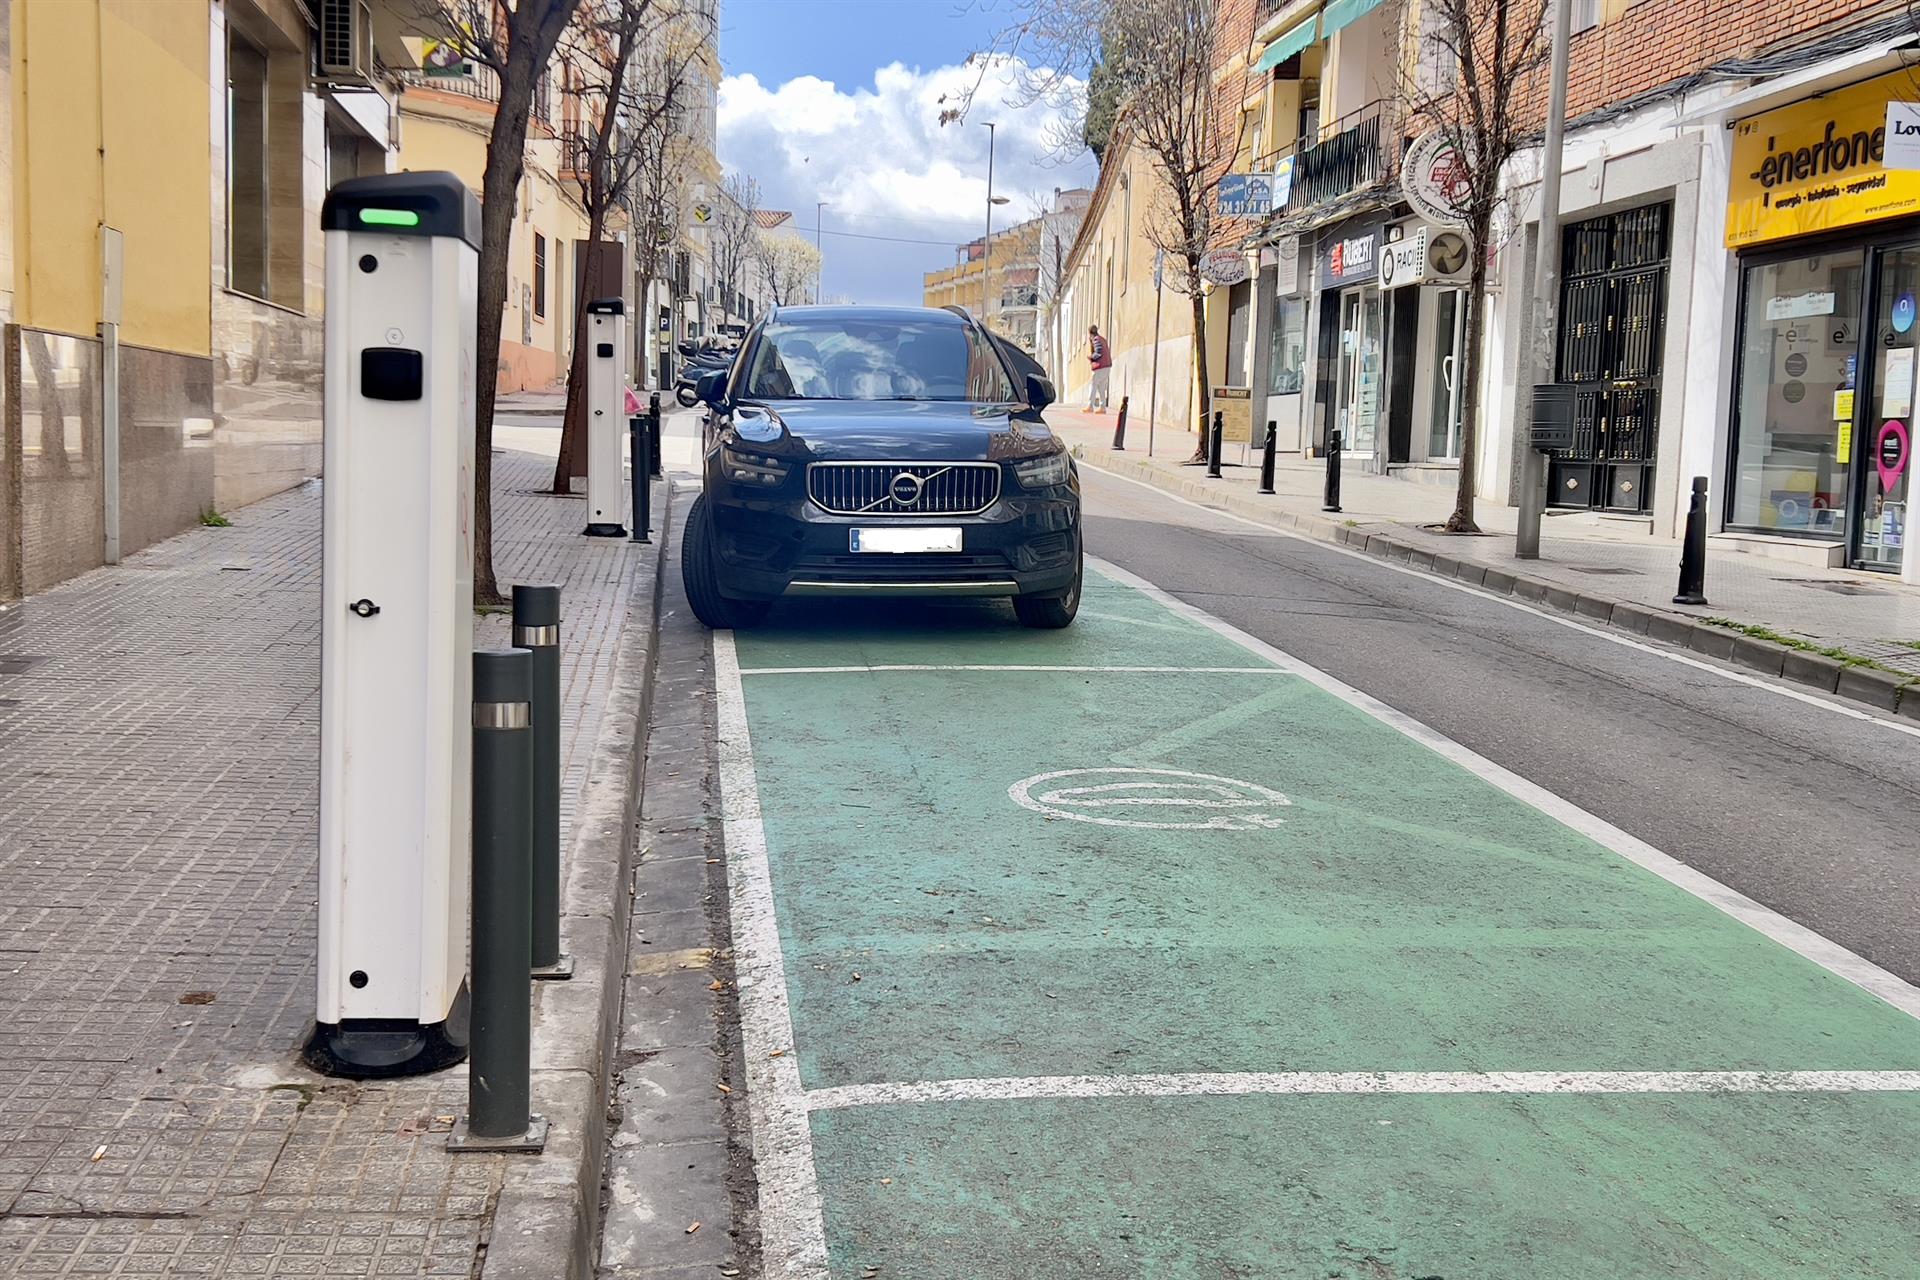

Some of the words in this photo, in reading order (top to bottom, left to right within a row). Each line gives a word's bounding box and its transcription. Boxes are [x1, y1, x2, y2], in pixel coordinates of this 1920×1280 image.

[1759, 120, 1885, 188] enerfone
[1343, 234, 1375, 267] RUBERT
[660, 318, 668, 328] P
